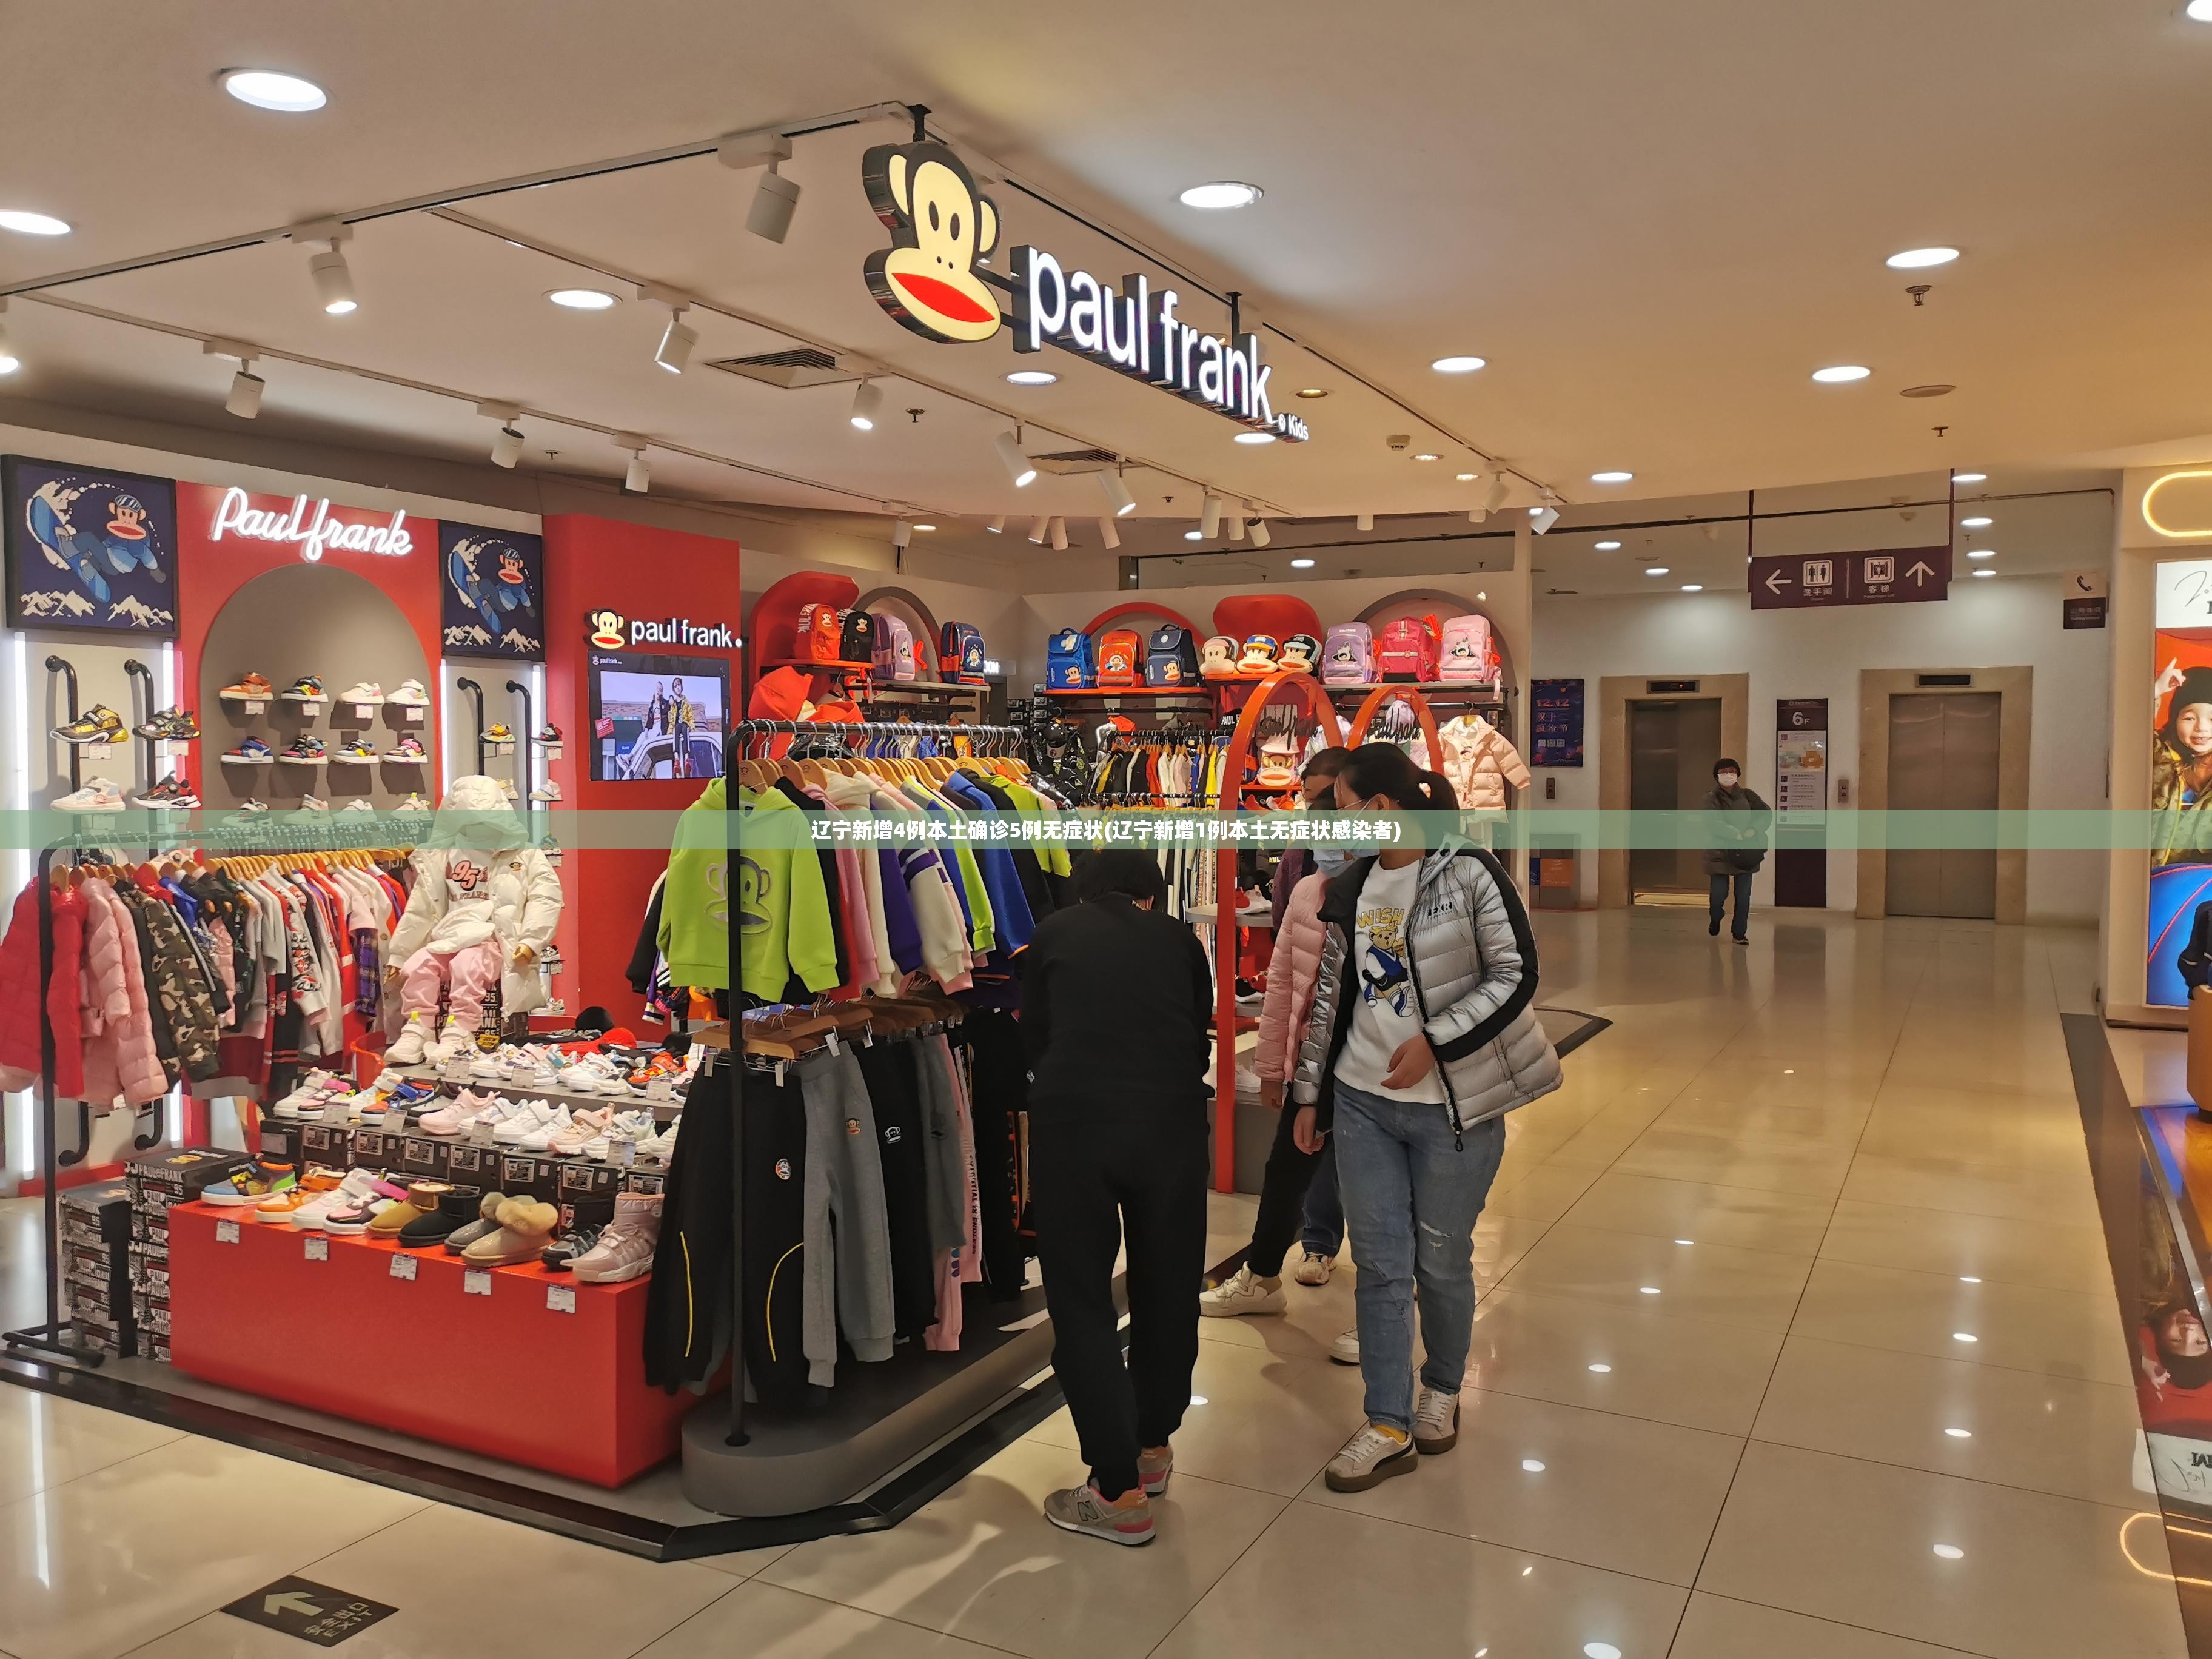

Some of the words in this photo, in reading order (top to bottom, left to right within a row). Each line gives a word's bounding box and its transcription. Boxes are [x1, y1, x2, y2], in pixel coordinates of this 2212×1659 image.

[1028, 245, 1151, 374] paul
[1159, 290, 1274, 424] frank
[1288, 414, 1309, 441] Kids
[631, 617, 677, 645] paul
[680, 618, 733, 648] frank
[452, 860, 480, 891] 95
[1357, 907, 1405, 928] WISH
[321, 1609, 373, 1638] EXIT
